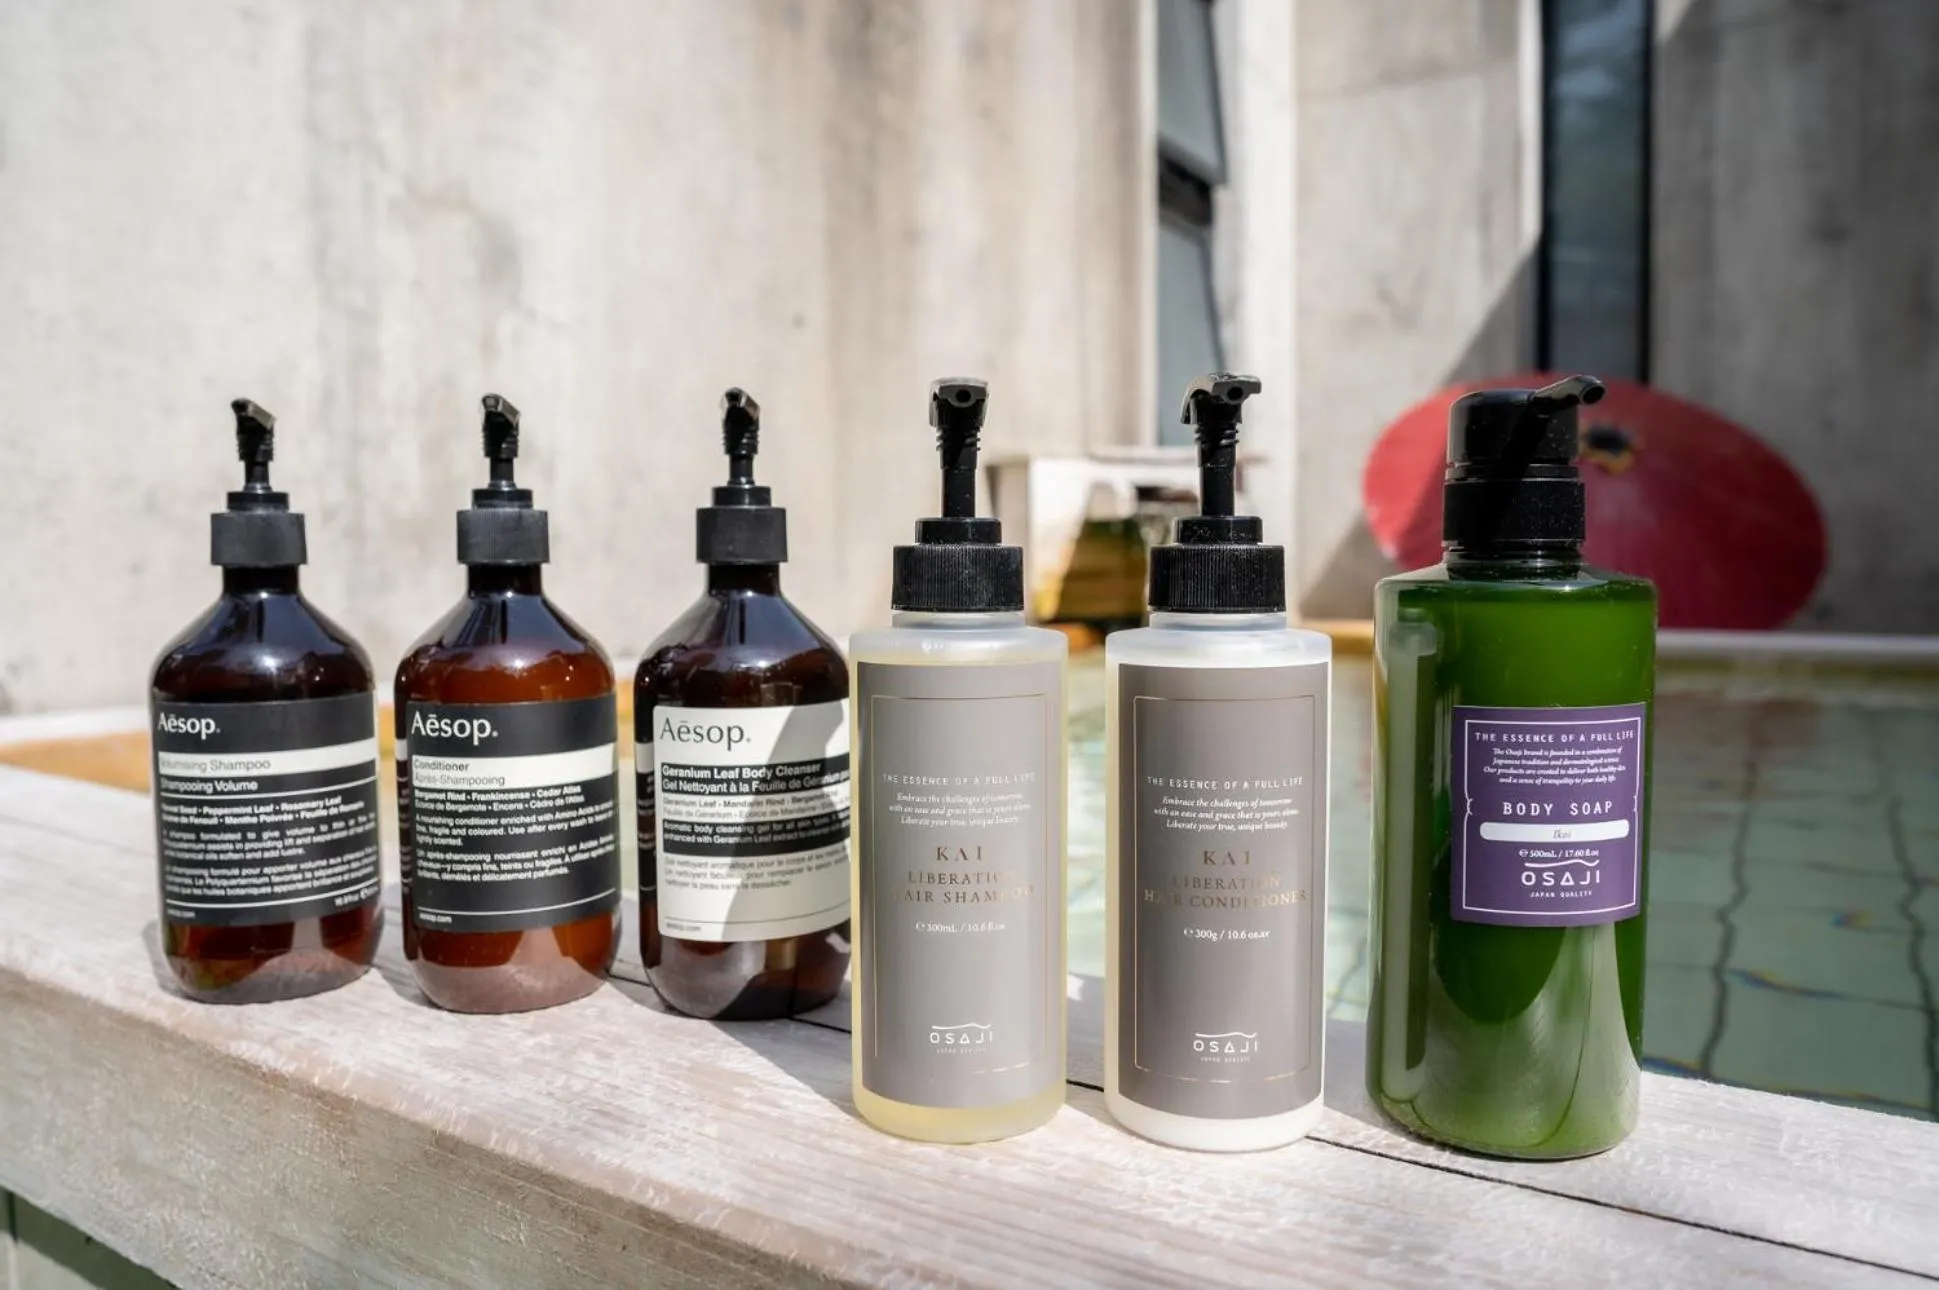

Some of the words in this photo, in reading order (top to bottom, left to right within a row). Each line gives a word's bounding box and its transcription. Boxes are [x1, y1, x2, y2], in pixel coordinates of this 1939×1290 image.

[411, 710, 499, 746] Aēsop.
[660, 717, 751, 752] Aēsop.
[1475, 732, 1497, 742] THE
[1503, 733, 1554, 743] ESSENCE
[1561, 733, 1574, 743] OF
[1579, 733, 1586, 742] A
[1591, 732, 1613, 742] FULL
[1616, 729, 1634, 740] LIFE
[1493, 747, 1505, 755] The
[1524, 748, 1543, 756] brand
[210, 759, 271, 771] Shampoo
[414, 760, 469, 771] Conditioner
[662, 765, 711, 778] Geranium
[713, 767, 739, 779] Leaf
[742, 766, 773, 780] Body
[775, 763, 821, 777] Cleanser
[214, 780, 258, 791] Volume
[663, 779, 678, 791] Gel
[679, 780, 727, 795] Nettoyant
[729, 781, 737, 793] à
[739, 781, 749, 792] la
[751, 780, 786, 792] Feuille
[789, 778, 801, 789] de
[903, 776, 949, 785] ESSENCE
[1148, 776, 1164, 786] THE
[1169, 778, 1218, 790] ESSENCE
[1224, 781, 1238, 790] OF
[1243, 780, 1249, 790] A
[1255, 780, 1280, 789] FULL
[1283, 776, 1302, 787] LIFE
[1196, 798, 1208, 807] the
[1210, 798, 1249, 809] challenges
[1502, 802, 1553, 816] BODY
[1569, 801, 1612, 816] SOAP
[1198, 810, 1214, 819] and
[1214, 812, 1236, 822] grace
[1237, 811, 1254, 819] that
[1166, 819, 1197, 829] Liberate
[1198, 823, 1217, 833] your
[1521, 870, 1600, 886] OSAJI
[897, 888, 934, 902] AIR
[1144, 889, 1183, 908] HR
[1227, 929, 1246, 940] 10.6
[930, 1030, 993, 1044] OSAJI
[1193, 1038, 1258, 1053] OSAJI
